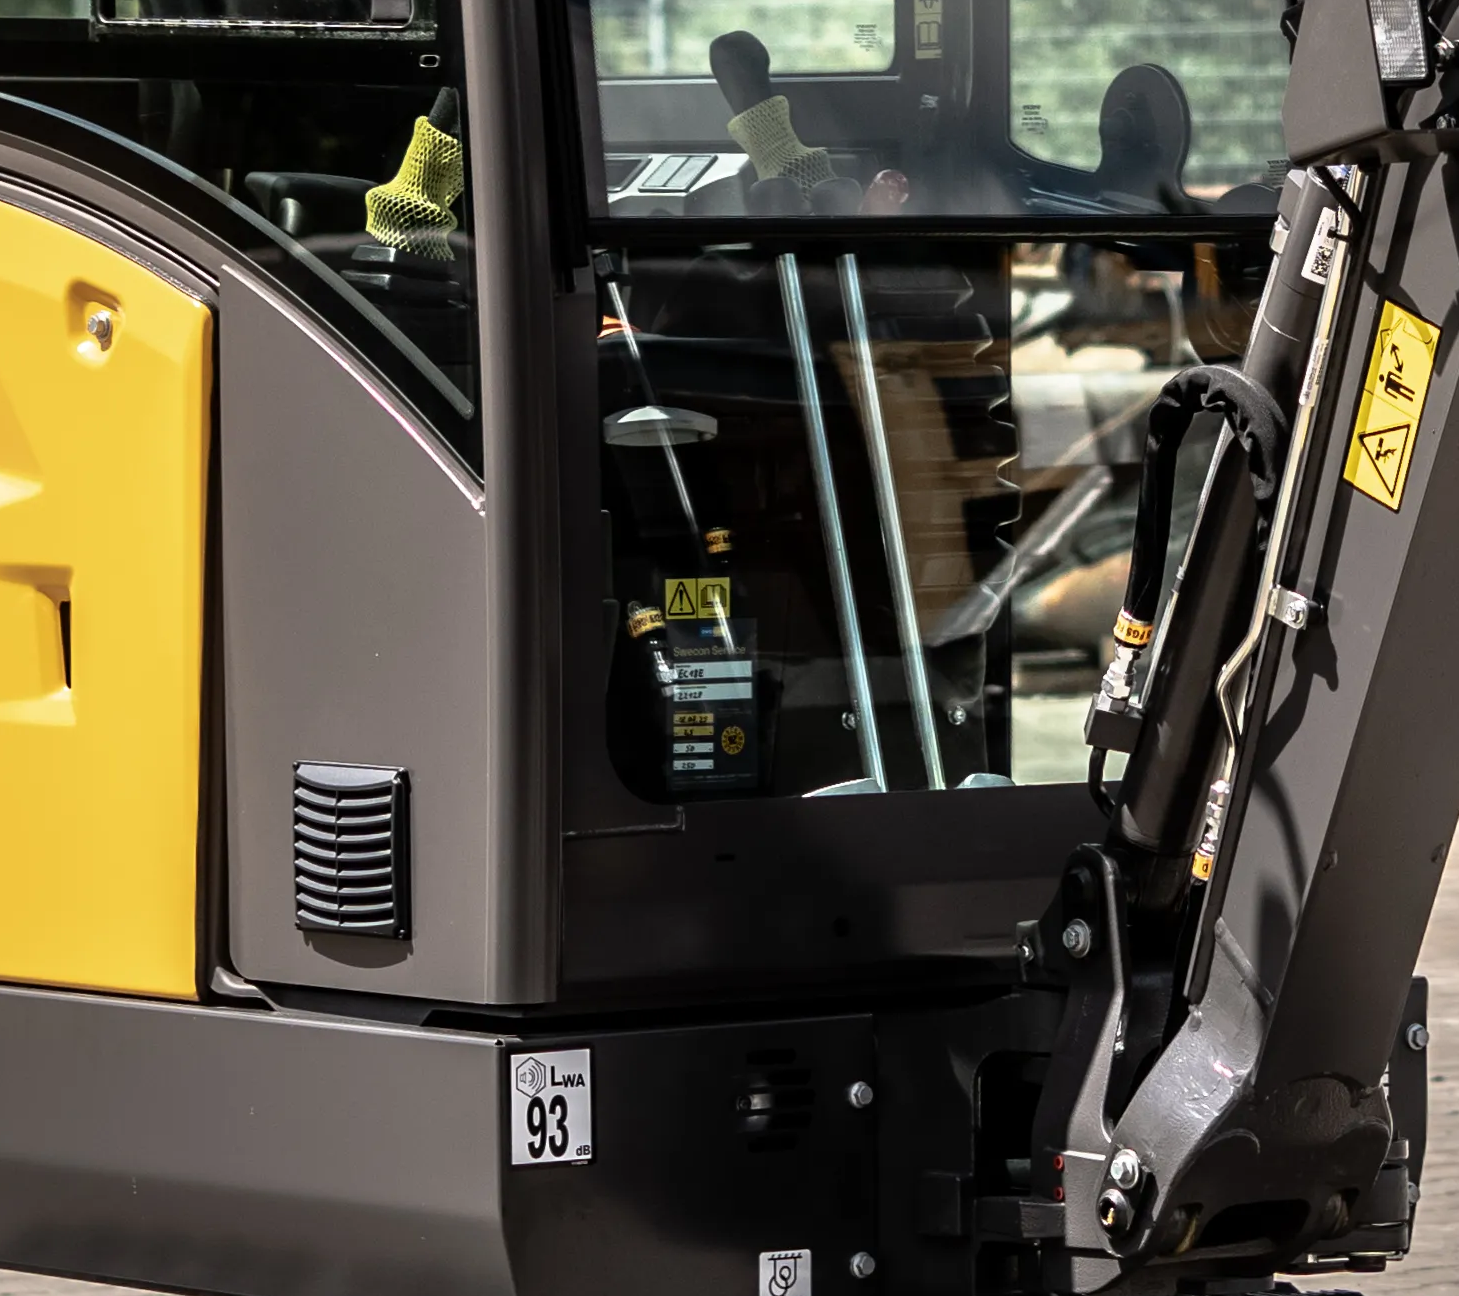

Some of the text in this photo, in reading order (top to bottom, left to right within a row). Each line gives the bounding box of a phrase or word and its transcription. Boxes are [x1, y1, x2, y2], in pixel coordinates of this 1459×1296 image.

[550, 1065, 586, 1088] LWA
[526, 1094, 570, 1159] 93
[575, 1144, 592, 1157] dB
